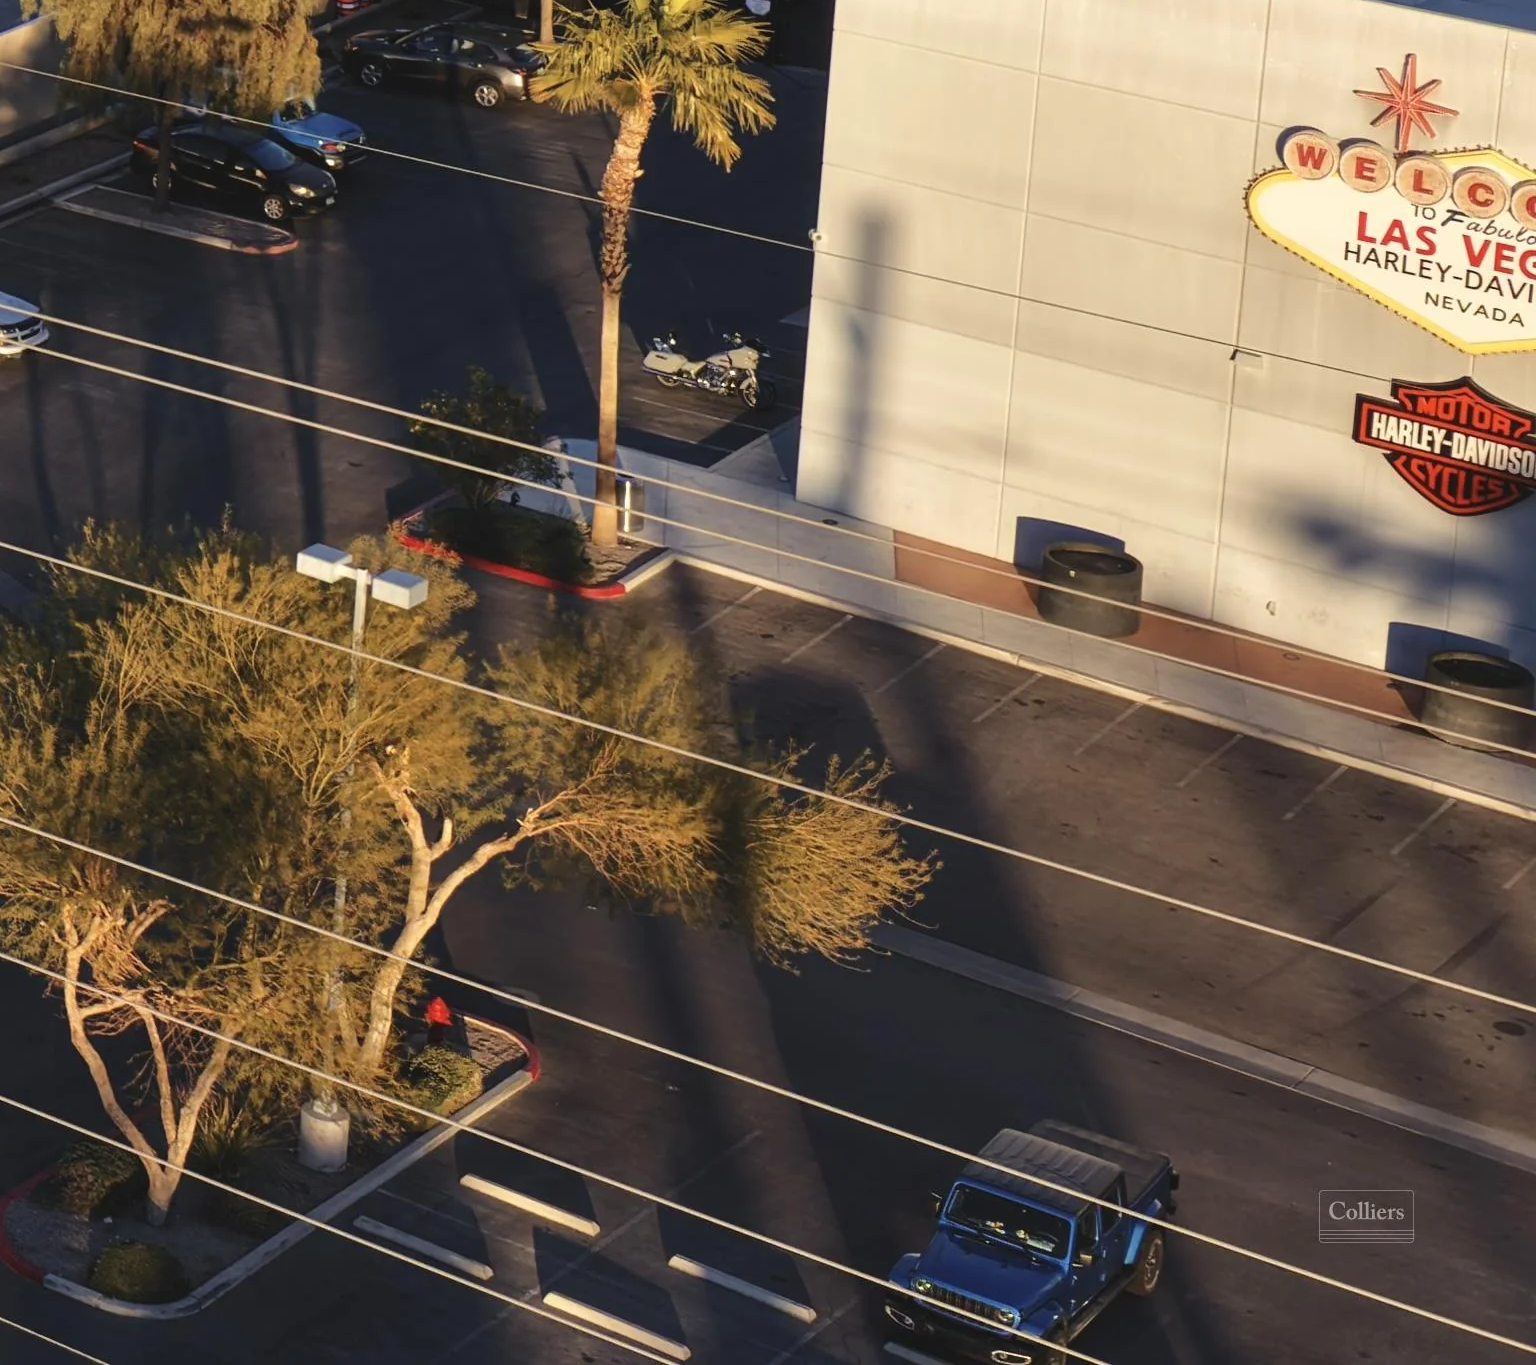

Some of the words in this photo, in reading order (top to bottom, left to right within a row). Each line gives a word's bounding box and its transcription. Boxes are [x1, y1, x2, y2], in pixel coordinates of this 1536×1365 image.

[1356, 211, 1437, 257] LAS
[1343, 241, 1534, 303] HARLEY-DAVI
[1424, 291, 1525, 327] NEVADA
[1416, 396, 1511, 436] MOTOR
[1371, 411, 1536, 480] HARLEY-DAVIDSO
[1410, 457, 1505, 505] CYCLES
